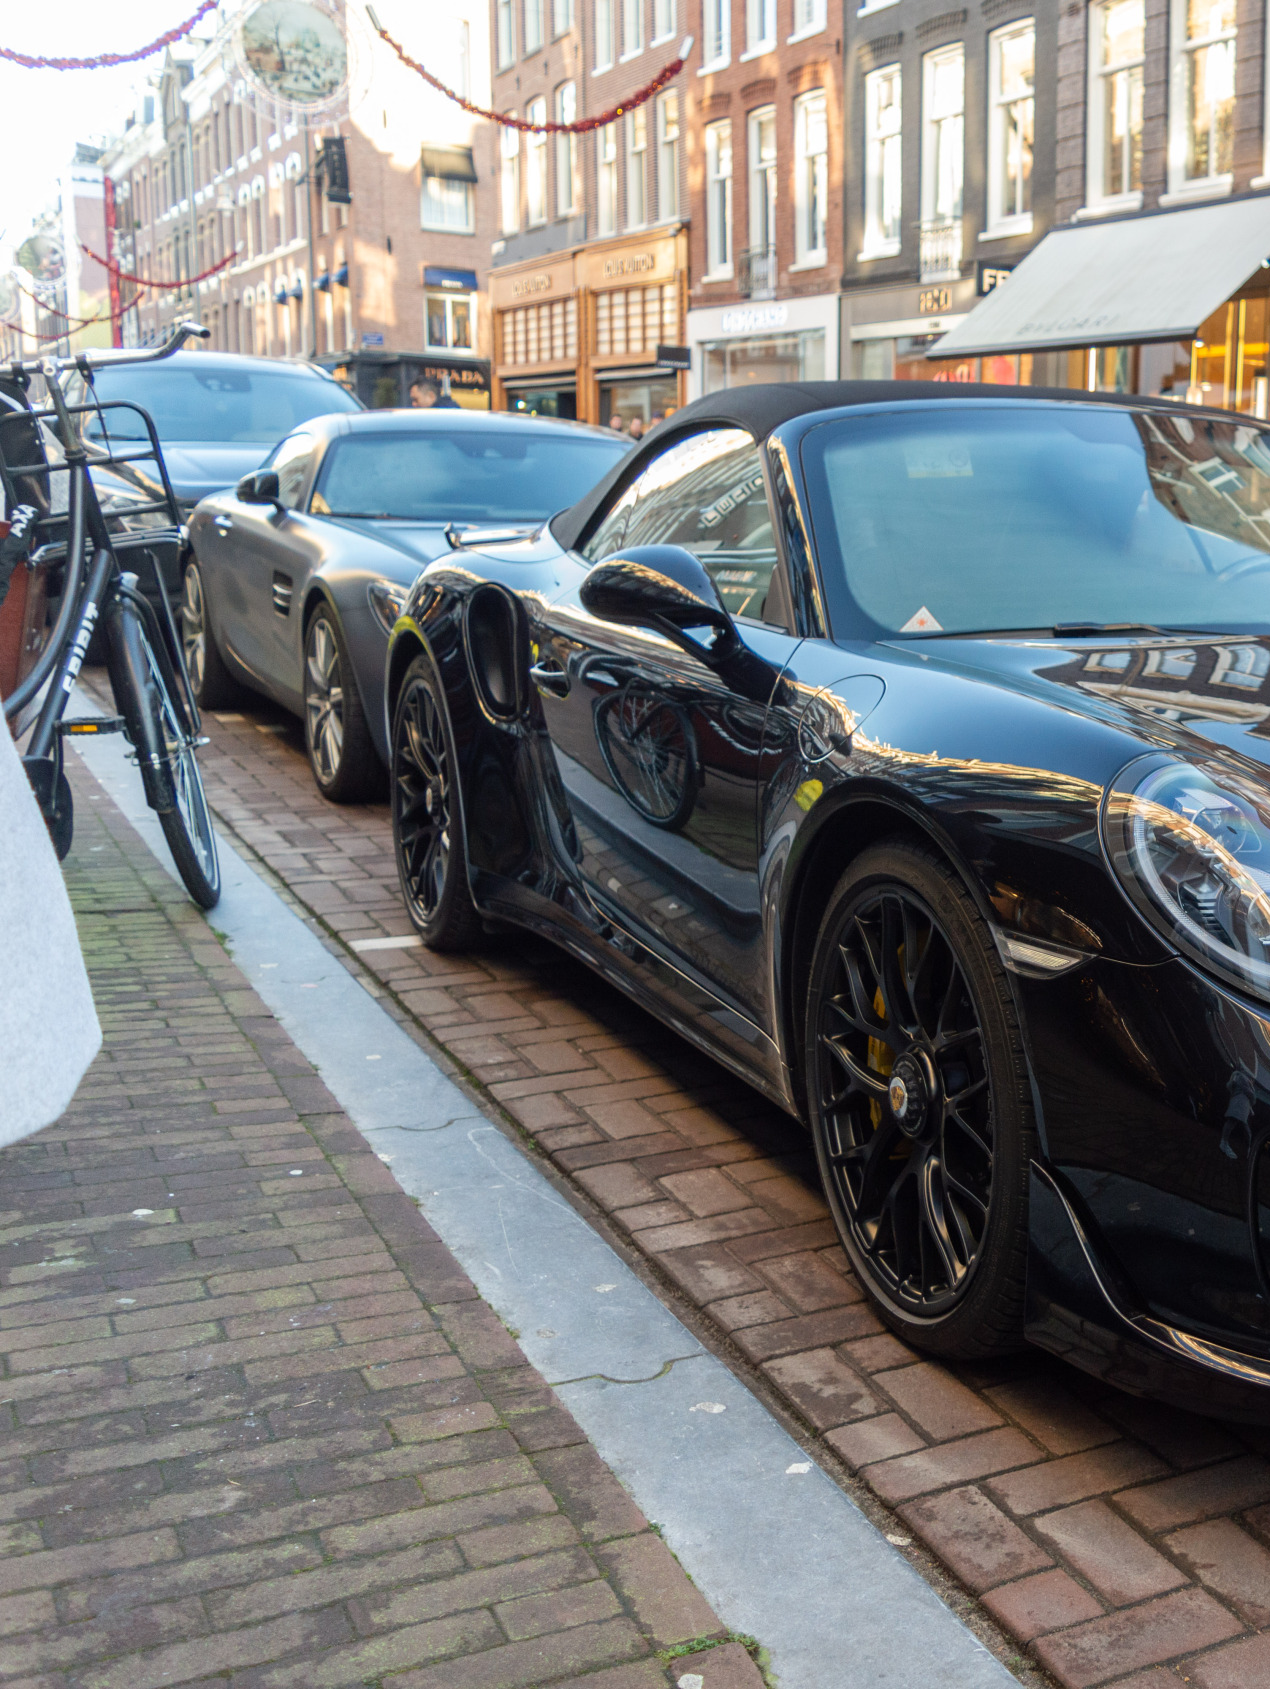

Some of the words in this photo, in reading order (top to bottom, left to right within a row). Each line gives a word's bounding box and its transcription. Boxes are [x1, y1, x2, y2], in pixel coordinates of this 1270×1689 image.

[602, 258, 624, 278] LOUIS
[625, 253, 656, 274] VUITTON
[424, 366, 485, 385] PRADA
[9, 503, 39, 538] AXA
